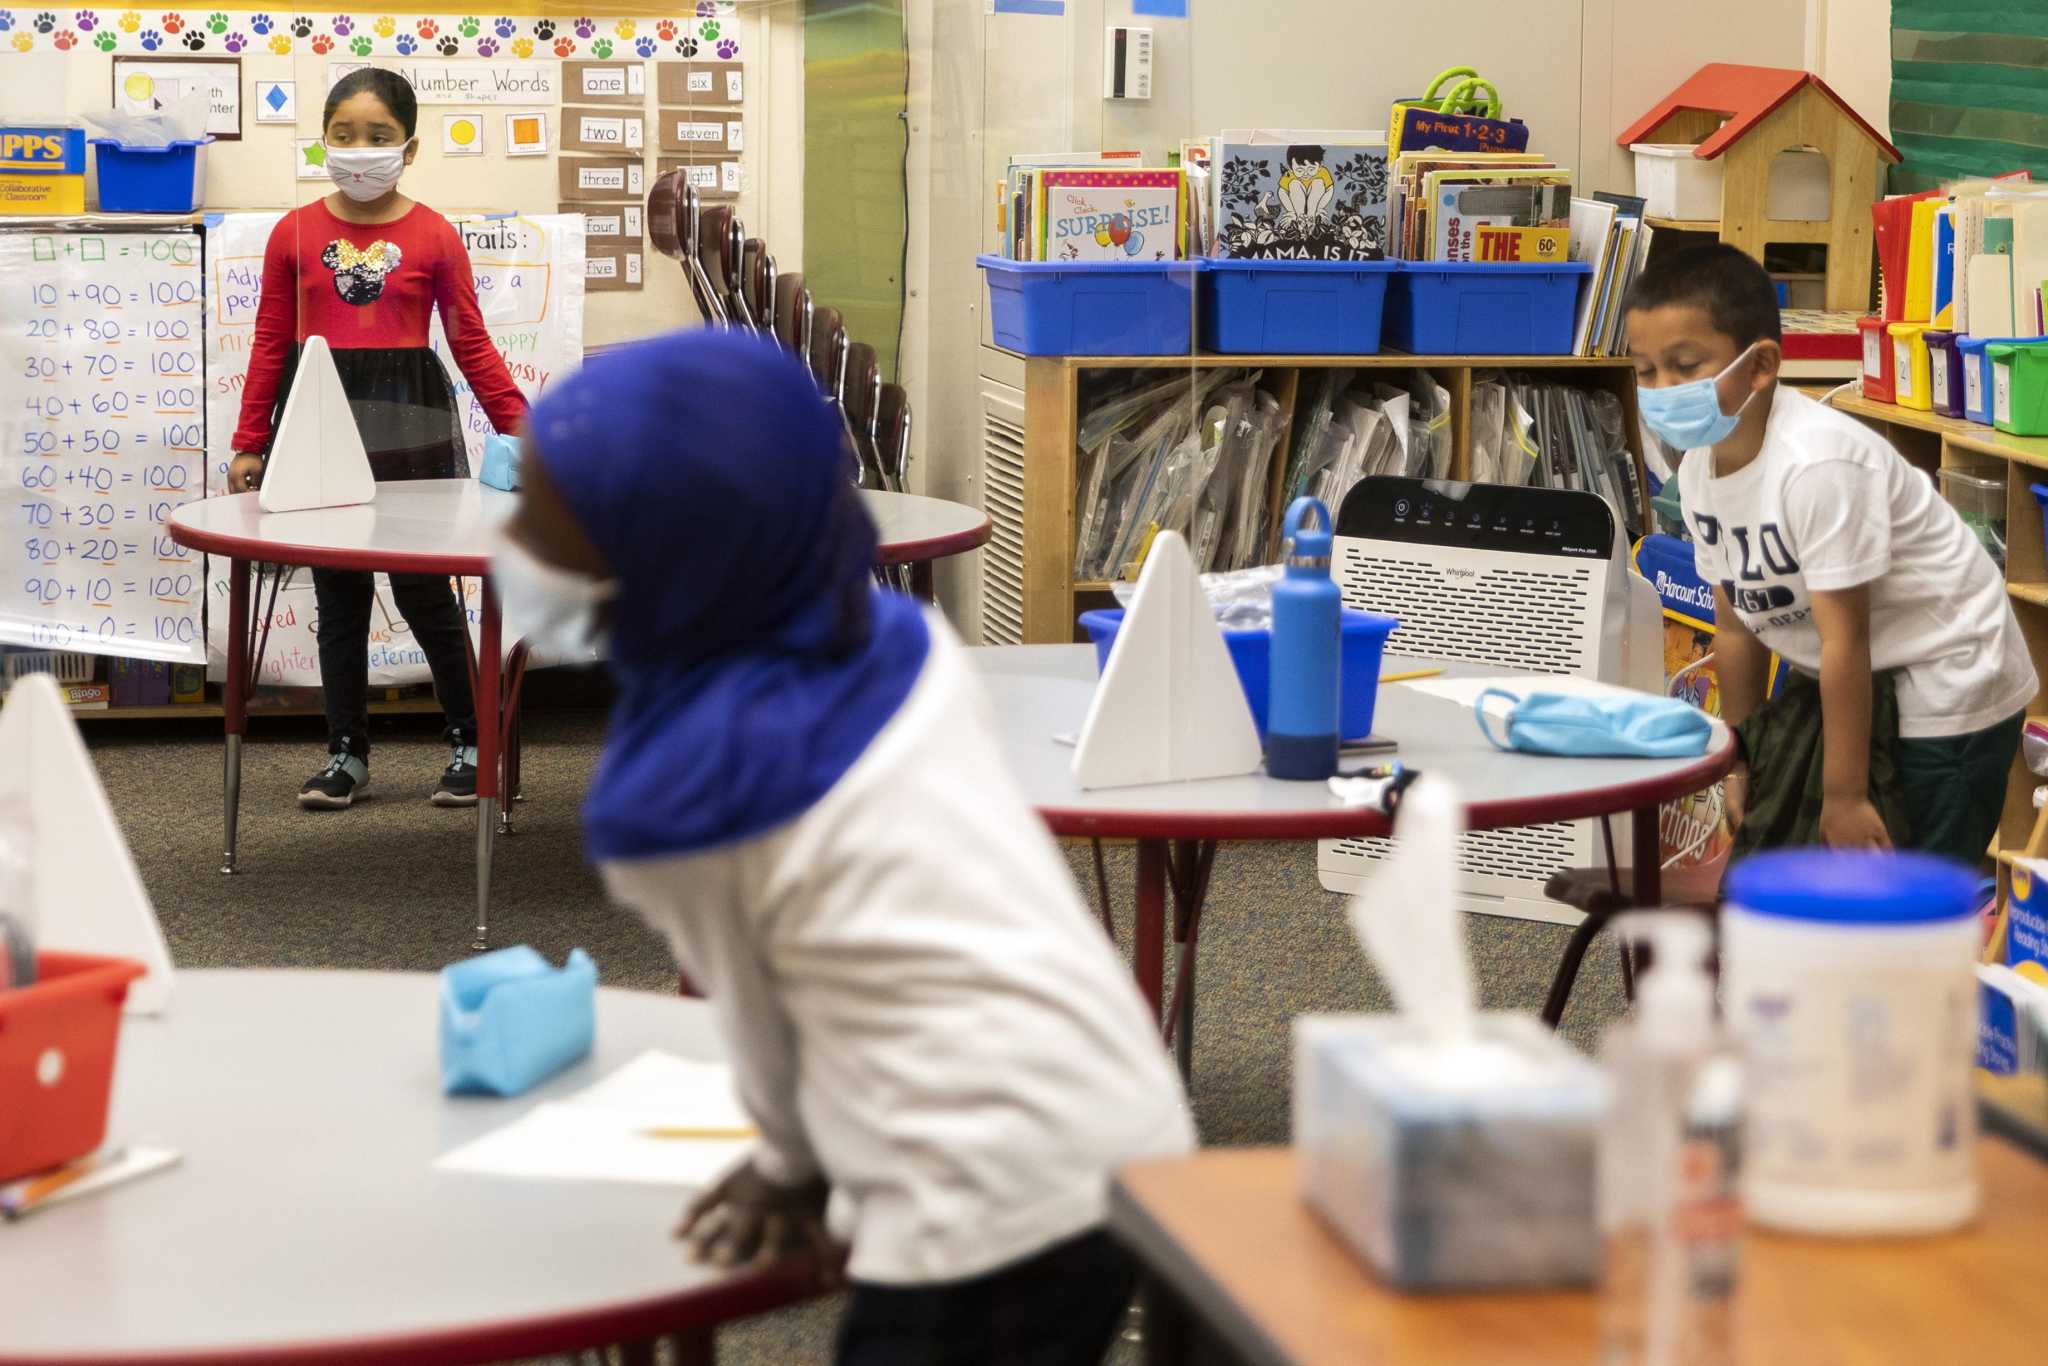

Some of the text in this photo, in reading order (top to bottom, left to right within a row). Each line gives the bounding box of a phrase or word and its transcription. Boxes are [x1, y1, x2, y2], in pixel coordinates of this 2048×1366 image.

[400, 69, 550, 92] Number Words
[587, 78, 621, 90] one
[691, 76, 739, 91] six 6
[208, 103, 235, 114] nter
[585, 125, 638, 141] two 2
[680, 129, 740, 140] seven 7
[0, 133, 63, 159] PPS
[583, 172, 639, 185] three 3
[688, 168, 735, 186] ight 8
[585, 215, 636, 232] four 4
[1055, 205, 1170, 239] SURPRISE!
[143, 239, 193, 263] 100
[1324, 245, 1341, 261] IS
[1479, 231, 1522, 262] THE
[226, 266, 263, 292] Adj
[586, 260, 637, 274] five 5
[33, 284, 57, 304] 10
[85, 284, 121, 304] 90
[149, 280, 195, 304] 100
[511, 274, 522, 288] a
[26, 318, 57, 338] 20
[83, 318, 120, 340] 80
[146, 320, 189, 338] 100
[496, 332, 538, 352] appy
[24, 356, 56, 378] 30
[84, 354, 117, 376] 70
[151, 351, 195, 373] 100
[1900, 361, 1907, 381] 2
[1936, 367, 1943, 387] 3
[26, 396, 64, 416] 40
[91, 391, 129, 413] 60
[156, 387, 194, 407] 100
[23, 431, 58, 454] 50
[82, 429, 120, 453] 50
[162, 424, 200, 447] 100
[22, 464, 57, 489] 60
[79, 465, 113, 490] 40
[143, 464, 187, 489] 100
[21, 503, 52, 526] 70
[78, 503, 115, 526] 30
[149, 502, 187, 522] 10
[25, 537, 61, 561] 80
[80, 538, 118, 561] 20
[1692, 509, 1800, 582] PLO
[24, 578, 62, 601] 90
[86, 577, 112, 601] 10
[149, 574, 193, 597] 100
[1662, 576, 1697, 606] Harcourt
[99, 616, 116, 643] 0
[155, 616, 194, 643] 100
[264, 647, 315, 683] ighter
[368, 644, 427, 668] eterm
[70, 687, 102, 700] Bingo
